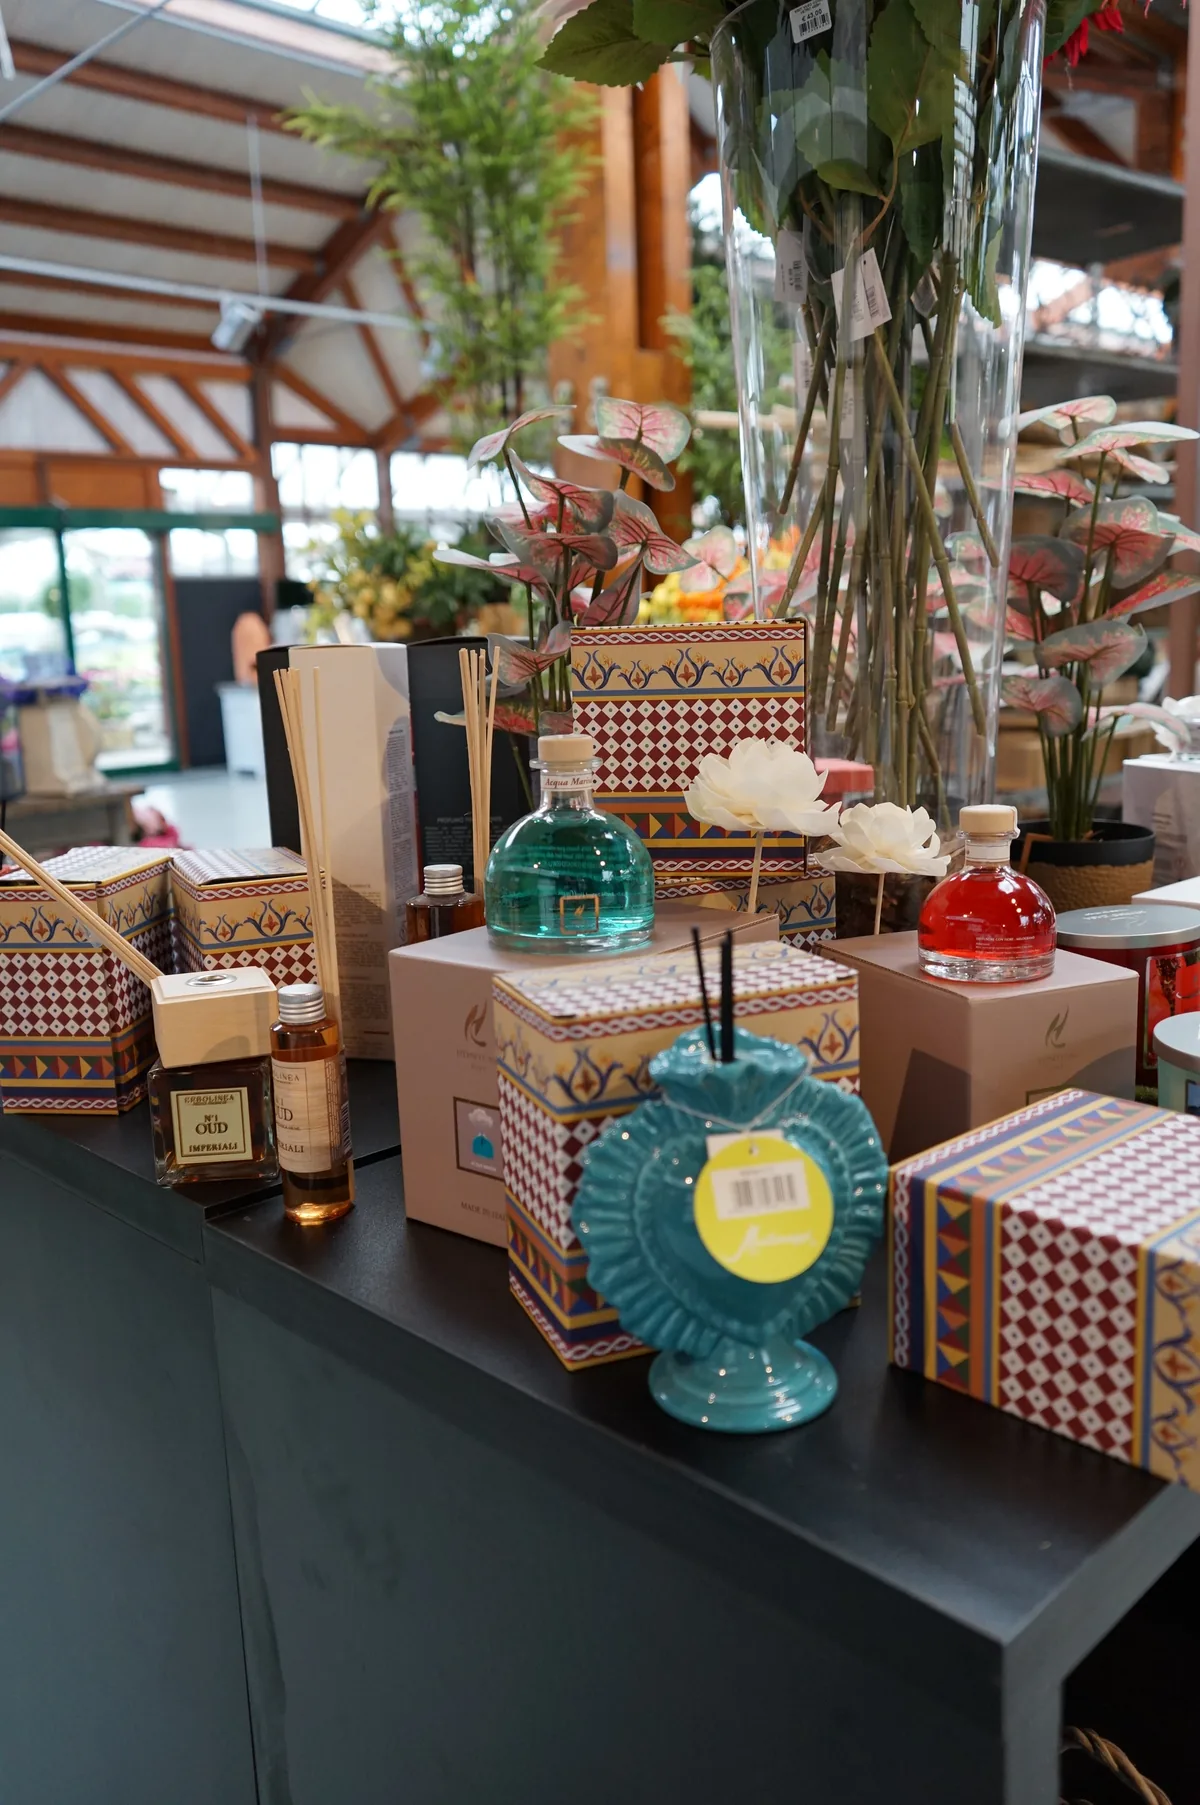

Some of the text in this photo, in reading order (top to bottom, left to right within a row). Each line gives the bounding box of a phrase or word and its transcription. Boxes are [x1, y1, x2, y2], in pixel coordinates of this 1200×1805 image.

[545, 777, 592, 788] Acqua Mari
[274, 1072, 300, 1082] LINEA
[276, 1105, 294, 1121] UD
[195, 1122, 228, 1135] OUD
[189, 1142, 238, 1153] IMPERIALI
[461, 1201, 481, 1214] MADE
